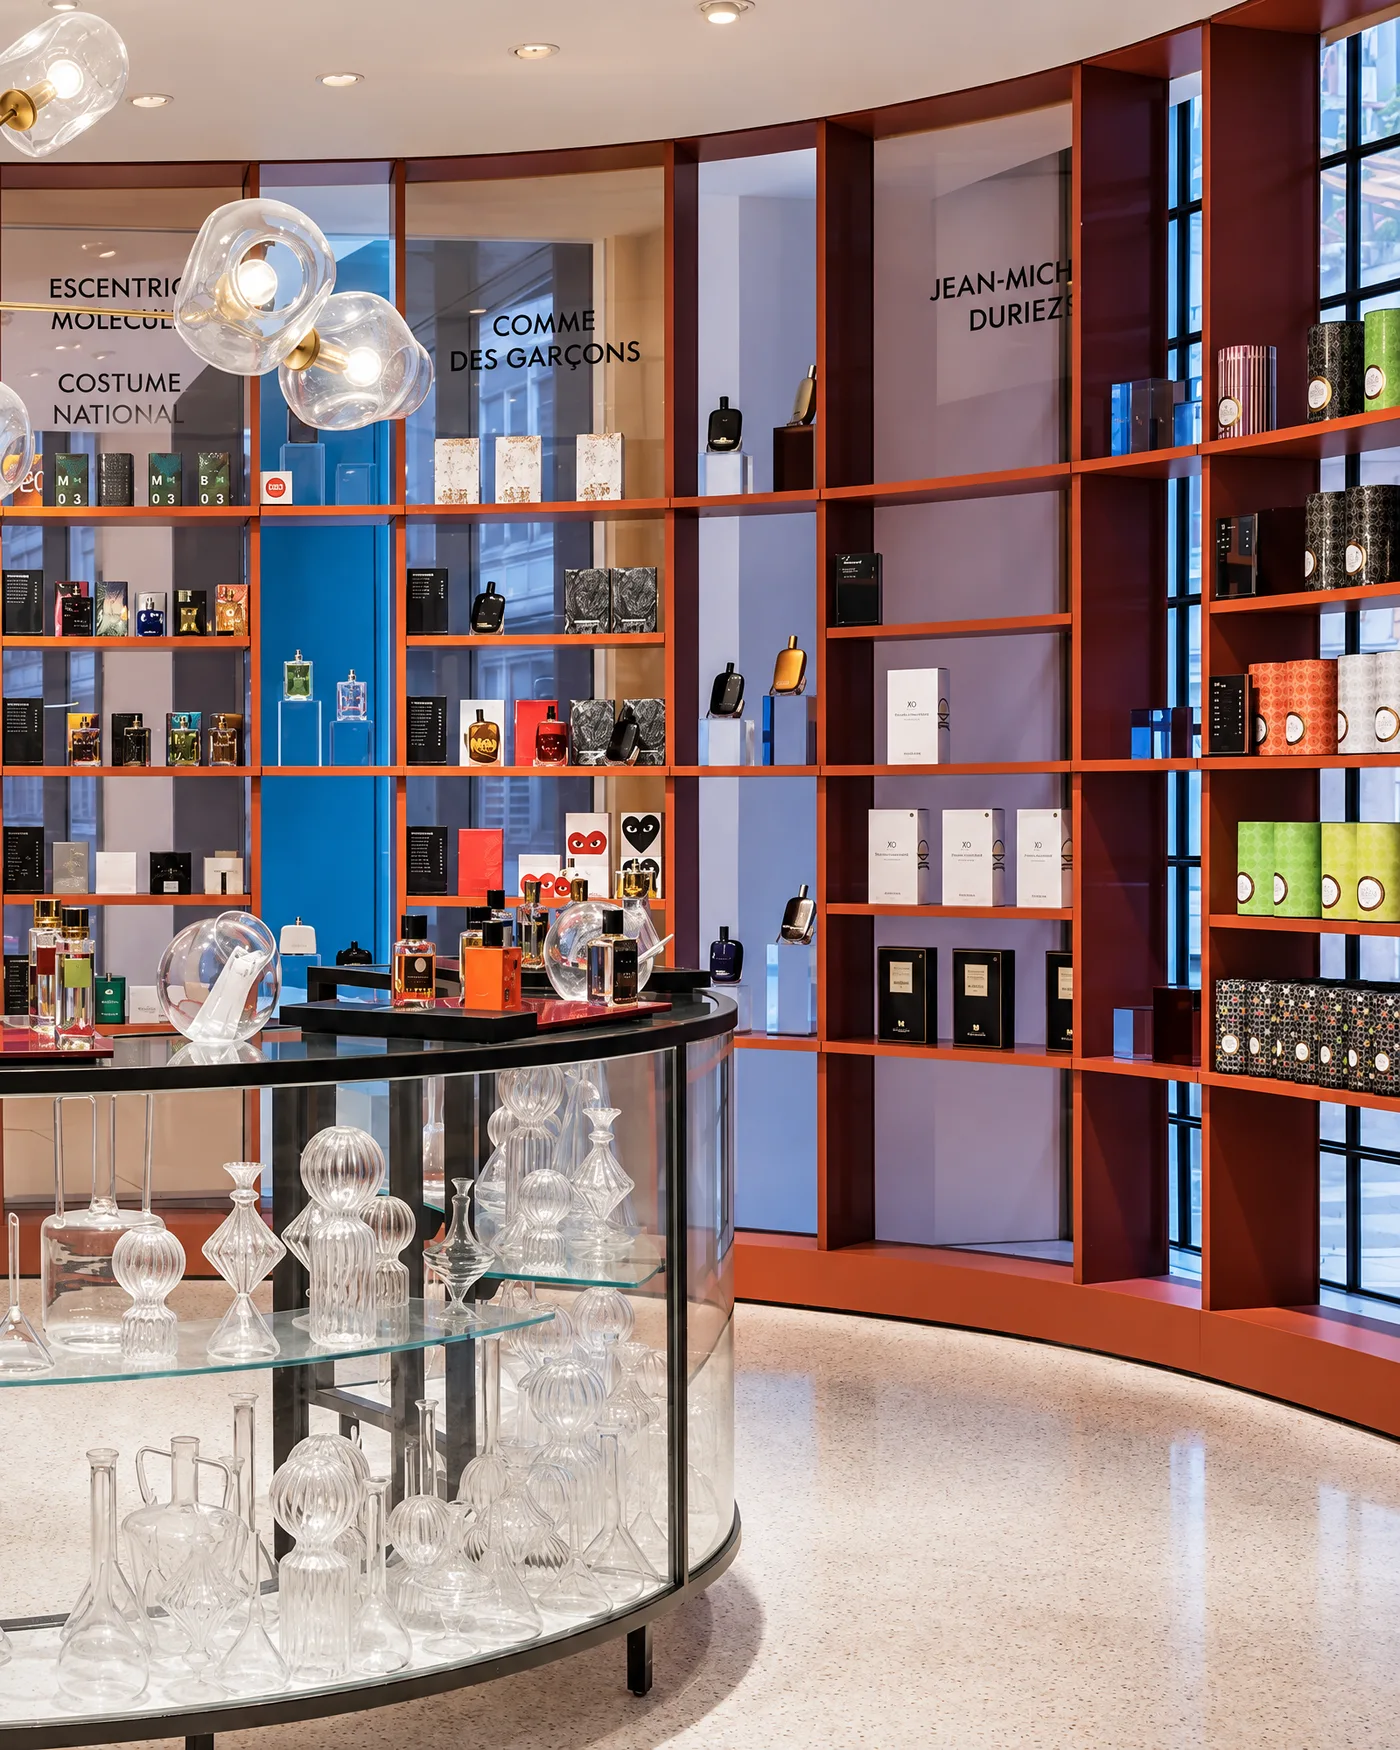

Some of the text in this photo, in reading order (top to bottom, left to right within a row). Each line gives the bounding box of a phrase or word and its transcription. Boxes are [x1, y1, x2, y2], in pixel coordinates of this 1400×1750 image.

[930, 259, 1072, 301] JEAN-MICH
[51, 308, 176, 330] MOLECUL
[493, 310, 595, 336] COMME
[970, 296, 1063, 331] DURIEZ
[450, 340, 640, 371] DES GARÇONS
[58, 373, 181, 393] COSTUME
[54, 404, 184, 424] NATIONAL
[907, 700, 917, 708] XO
[887, 841, 897, 849] XO
[962, 841, 972, 849] XO
